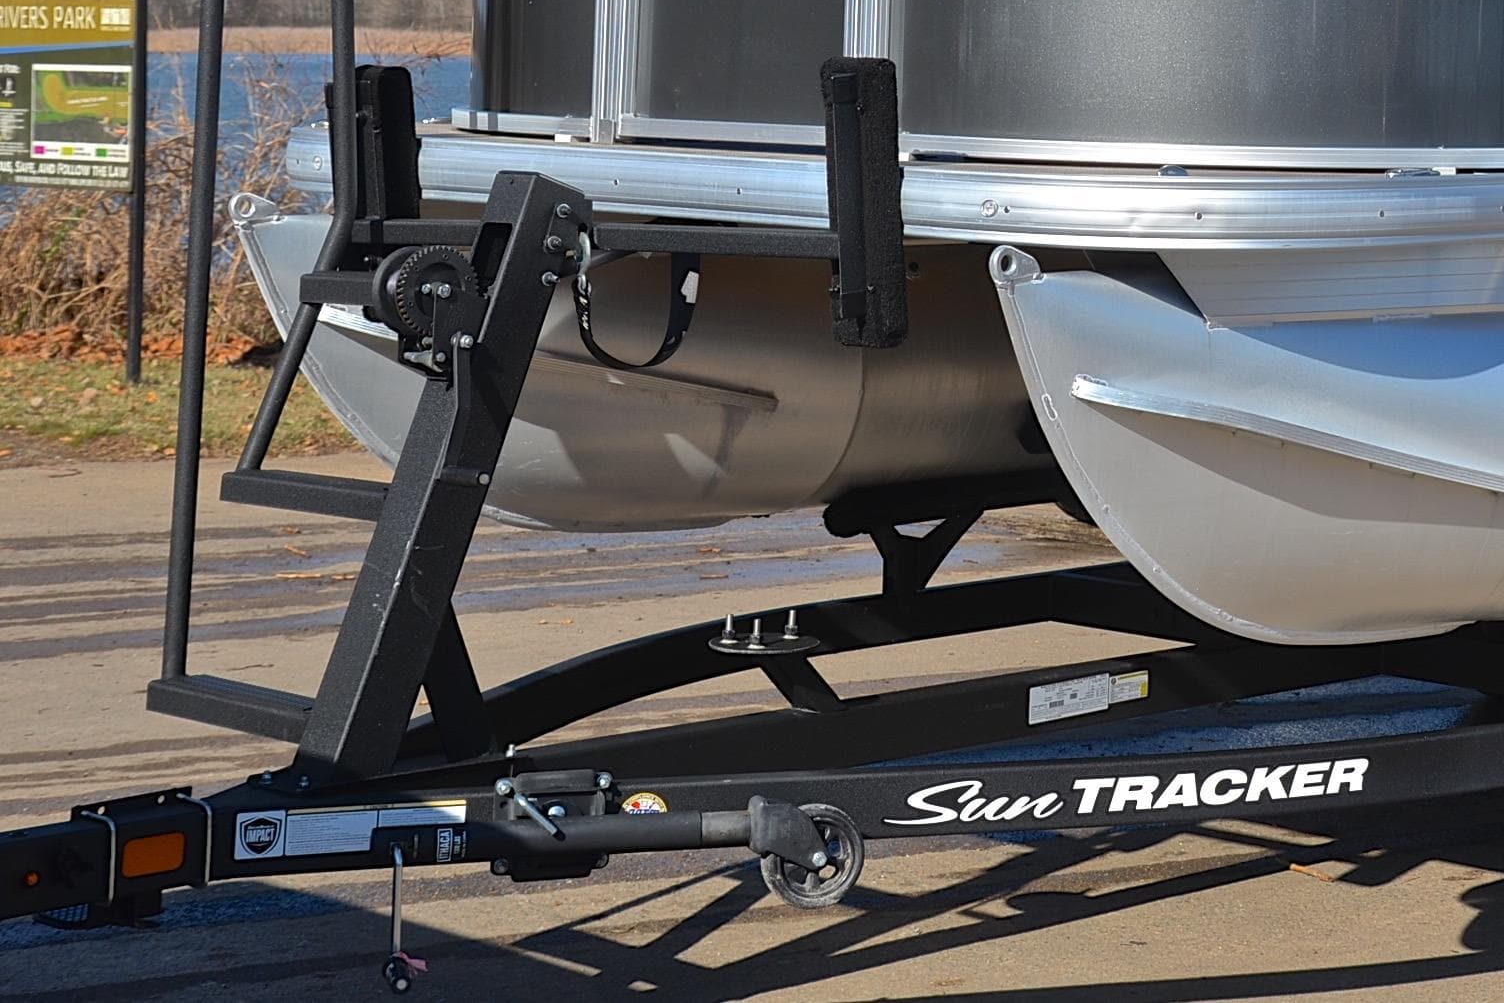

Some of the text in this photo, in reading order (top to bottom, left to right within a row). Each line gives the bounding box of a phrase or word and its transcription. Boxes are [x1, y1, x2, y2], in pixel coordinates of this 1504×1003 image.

[52, 6, 97, 30] PARK
[883, 758, 1369, 825] Sun TRACKER
[246, 828, 275, 843] IMPACT
[438, 831, 450, 860] ITHACA
